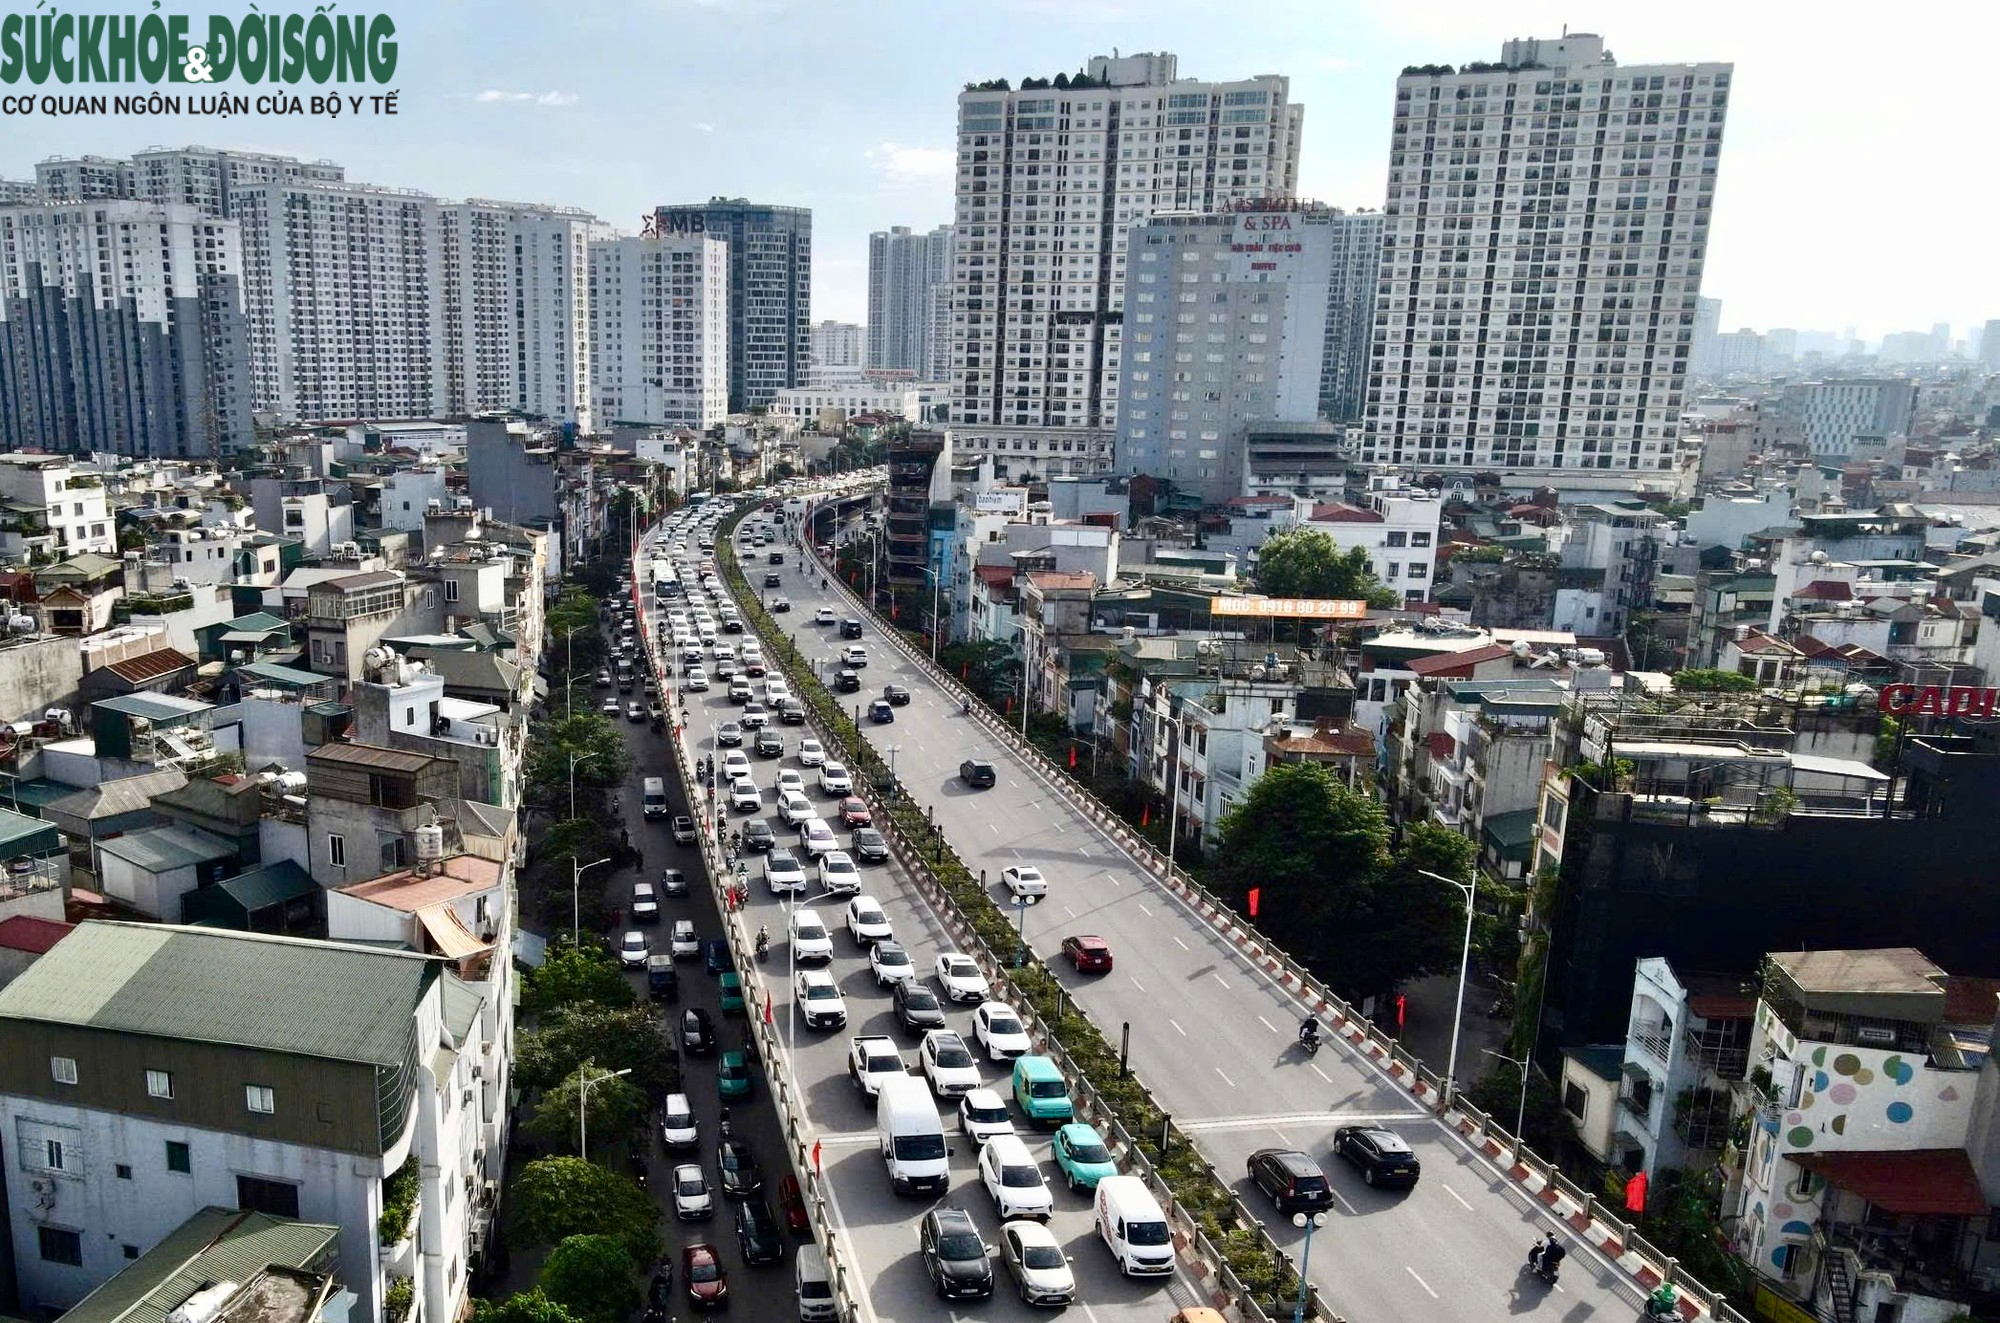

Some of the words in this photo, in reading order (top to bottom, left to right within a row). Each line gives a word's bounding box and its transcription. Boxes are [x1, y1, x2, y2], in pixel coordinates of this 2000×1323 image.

[669, 212, 706, 233] MB
[1244, 216, 1257, 230] &
[1261, 216, 1291, 230] SPA
[1340, 602, 1357, 614] 99
